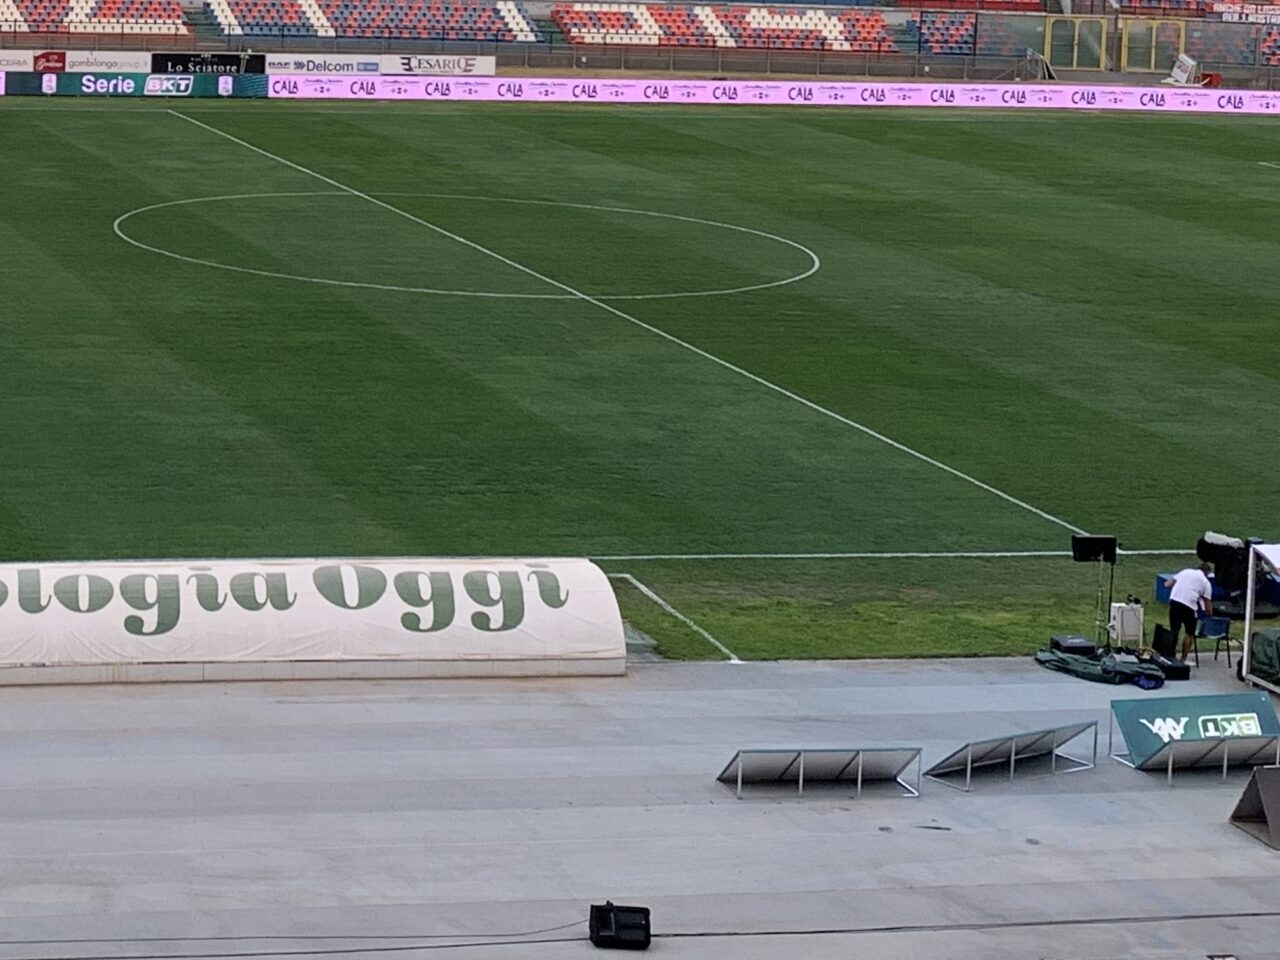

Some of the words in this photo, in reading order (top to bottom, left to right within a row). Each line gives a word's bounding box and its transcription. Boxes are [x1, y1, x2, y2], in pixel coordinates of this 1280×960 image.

[167, 61, 183, 72] Lo
[188, 61, 238, 73] Sciatore
[306, 59, 354, 72] Delcom
[81, 74, 135, 93] Serie
[149, 76, 192, 93] BKT
[272, 80, 299, 94] CALA
[350, 81, 376, 95] CALA
[424, 82, 451, 96] CALA
[497, 83, 523, 97] CALA
[572, 84, 598, 98] CALA
[643, 85, 669, 99] CALA
[712, 86, 738, 100] CALA
[788, 87, 813, 101] CALA
[860, 88, 886, 102] CALA
[930, 89, 955, 103] CALA
[1001, 90, 1027, 104] CALA
[1071, 91, 1097, 105] CALA
[1139, 93, 1166, 107] CALA
[1217, 95, 1244, 108] CALA
[312, 563, 570, 632] Oggi
[1202, 716, 1261, 737] BKT
